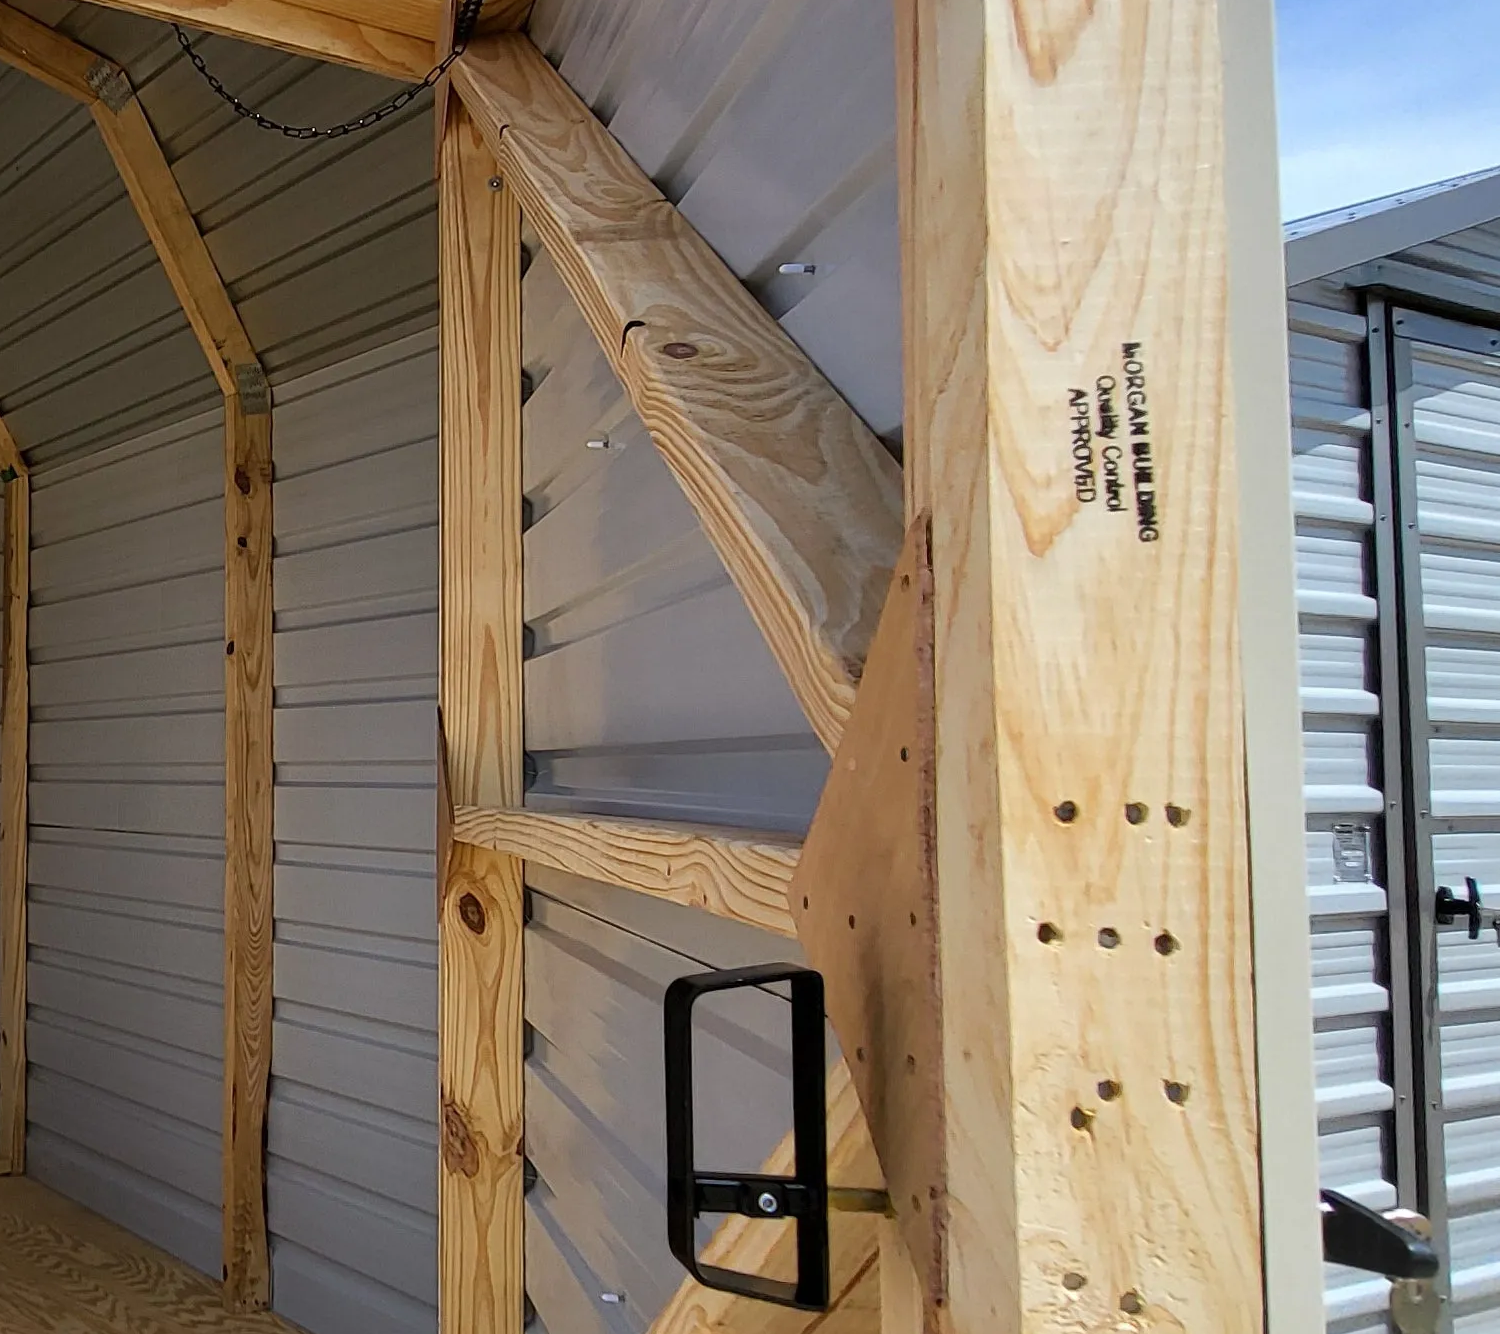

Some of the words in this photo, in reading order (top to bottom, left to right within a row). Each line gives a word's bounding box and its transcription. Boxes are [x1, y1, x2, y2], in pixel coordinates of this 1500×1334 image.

[1095, 375, 1121, 439] Quality
[1121, 342, 1150, 436] MORGAN
[1068, 388, 1097, 503] APPROVED
[1101, 445, 1128, 512] Control
[1131, 442, 1159, 543] BUILDING
